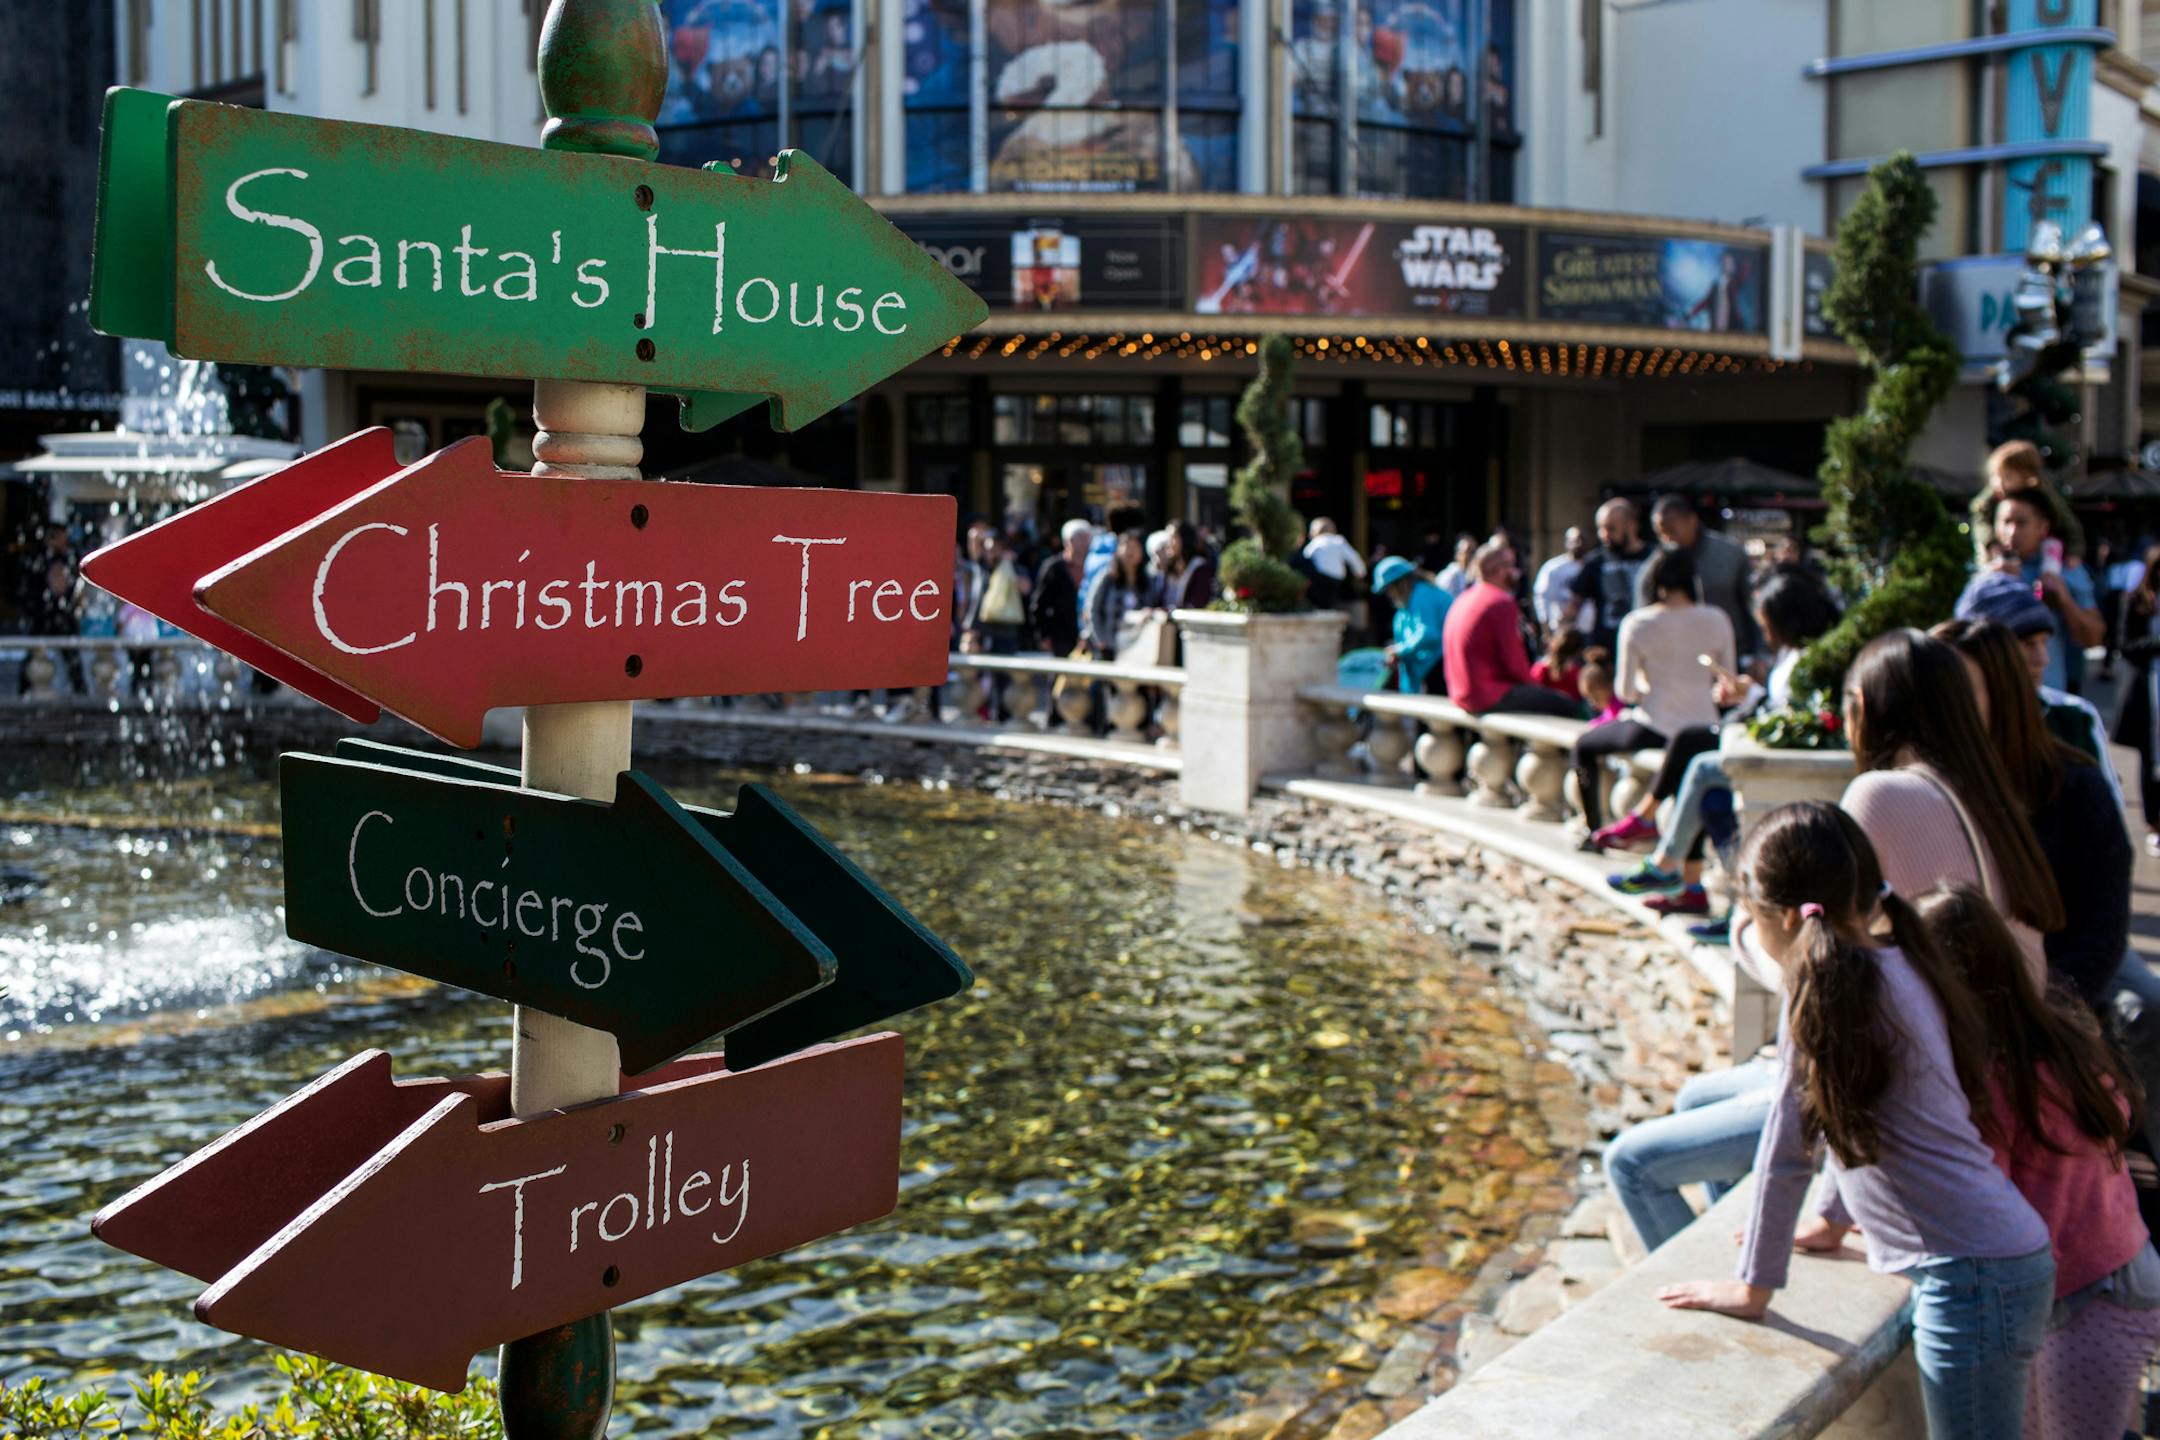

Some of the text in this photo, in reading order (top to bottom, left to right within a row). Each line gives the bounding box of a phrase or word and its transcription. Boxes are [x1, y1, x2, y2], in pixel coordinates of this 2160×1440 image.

[205, 168, 907, 335] Santa's House
[1399, 224, 1503, 254] STAR
[1401, 260, 1504, 291] WARS
[312, 521, 942, 655] Christmas Tree
[349, 810, 646, 989] Concierge
[478, 1130, 751, 1290] Trolley
